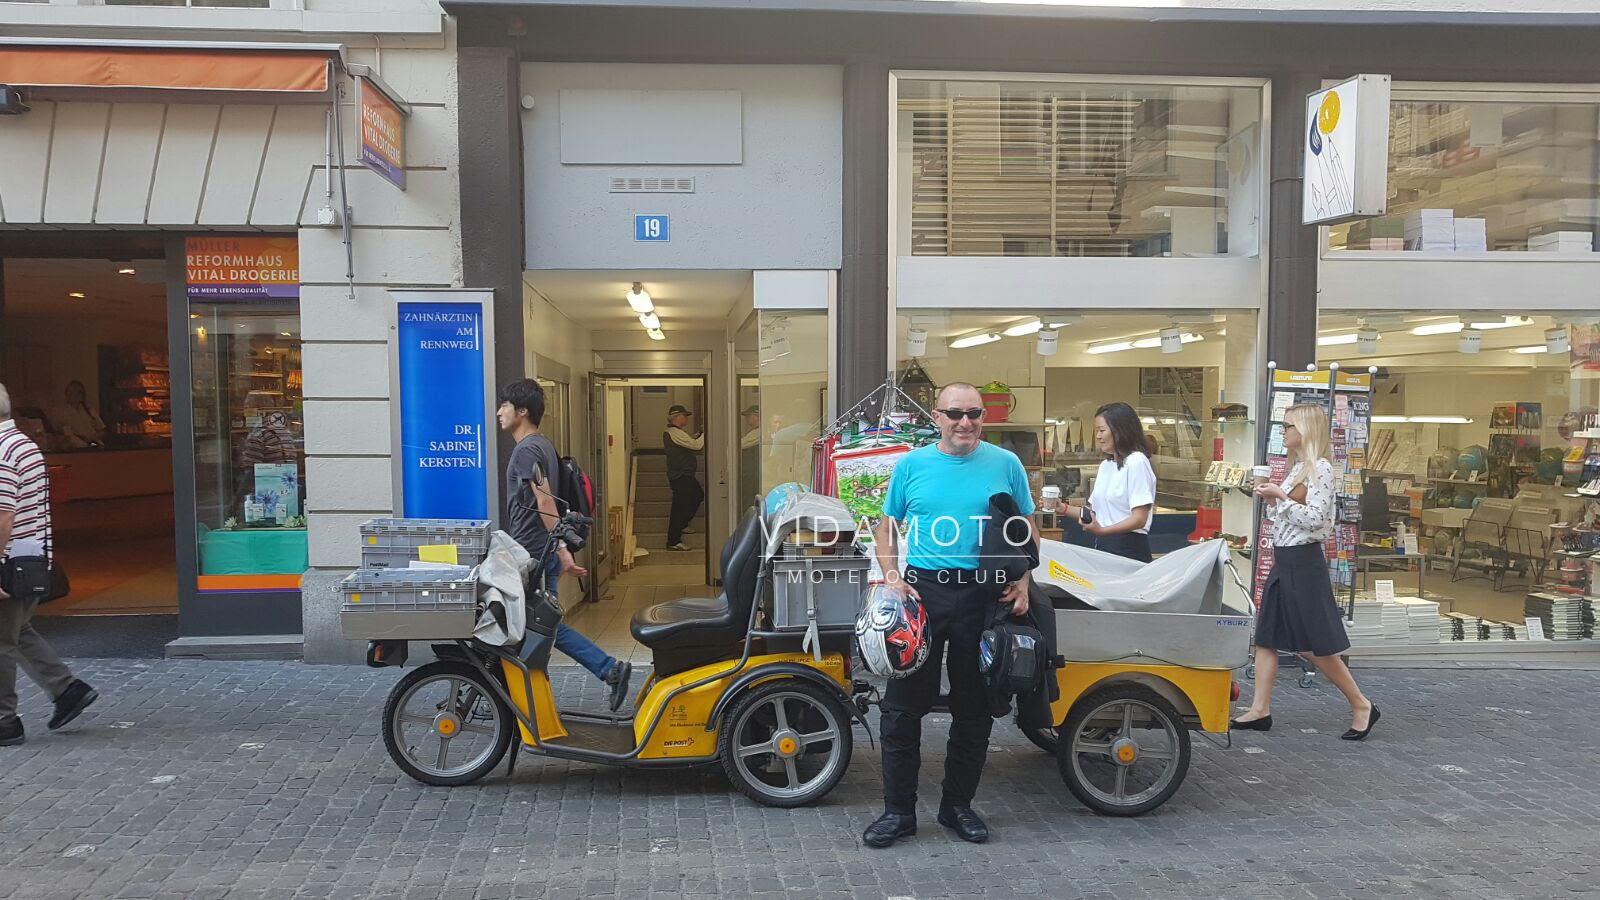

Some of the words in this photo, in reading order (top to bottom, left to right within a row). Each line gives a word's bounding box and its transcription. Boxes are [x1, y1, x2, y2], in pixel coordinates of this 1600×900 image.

[644, 218, 660, 238] 19
[186, 238, 240, 252] MÜLLER
[186, 255, 283, 267] REFORMHAUS
[187, 269, 227, 281] VITAL
[230, 269, 298, 281] DROGERIE
[219, 286, 268, 294] LEBENSQUALITÄT
[404, 311, 473, 322] ZAHNÄRZTIN
[456, 327, 473, 336] AM
[420, 340, 474, 350] RENNWEG
[454, 424, 476, 435] DR.
[429, 441, 476, 451] SABINE
[419, 457, 476, 468] KERSTEN
